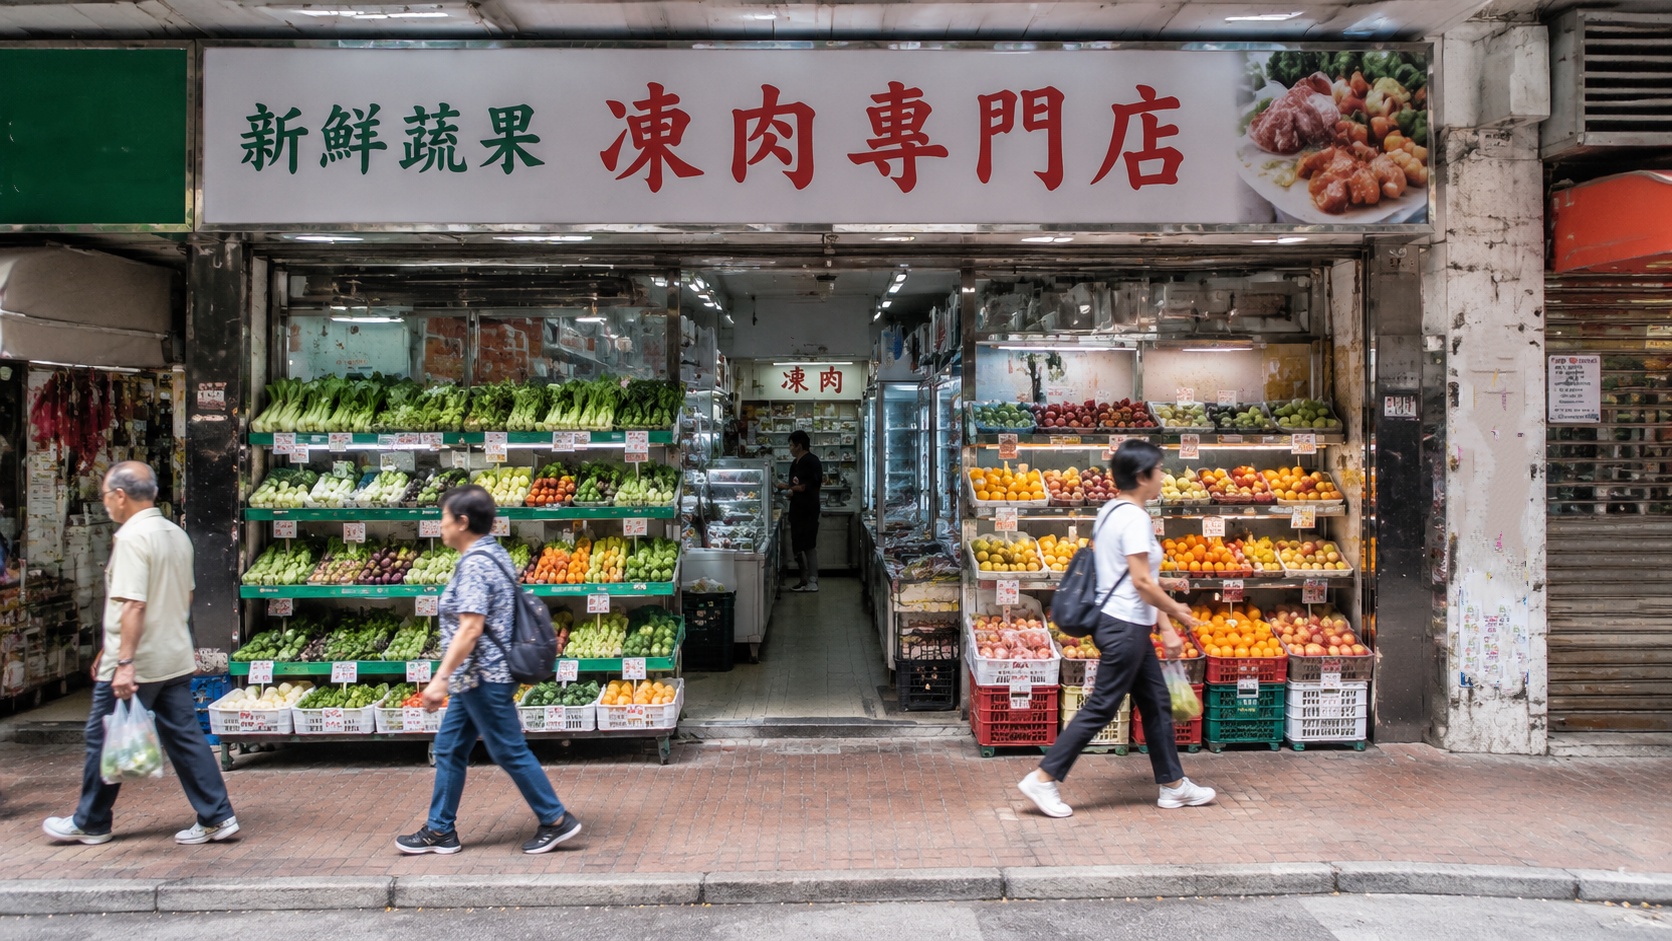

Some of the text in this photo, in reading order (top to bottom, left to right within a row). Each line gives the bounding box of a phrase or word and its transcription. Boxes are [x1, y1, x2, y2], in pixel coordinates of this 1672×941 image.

[240, 81, 1185, 194] 新鮮蔬果 凍肉專門店
[781, 365, 843, 394] 凍肉
